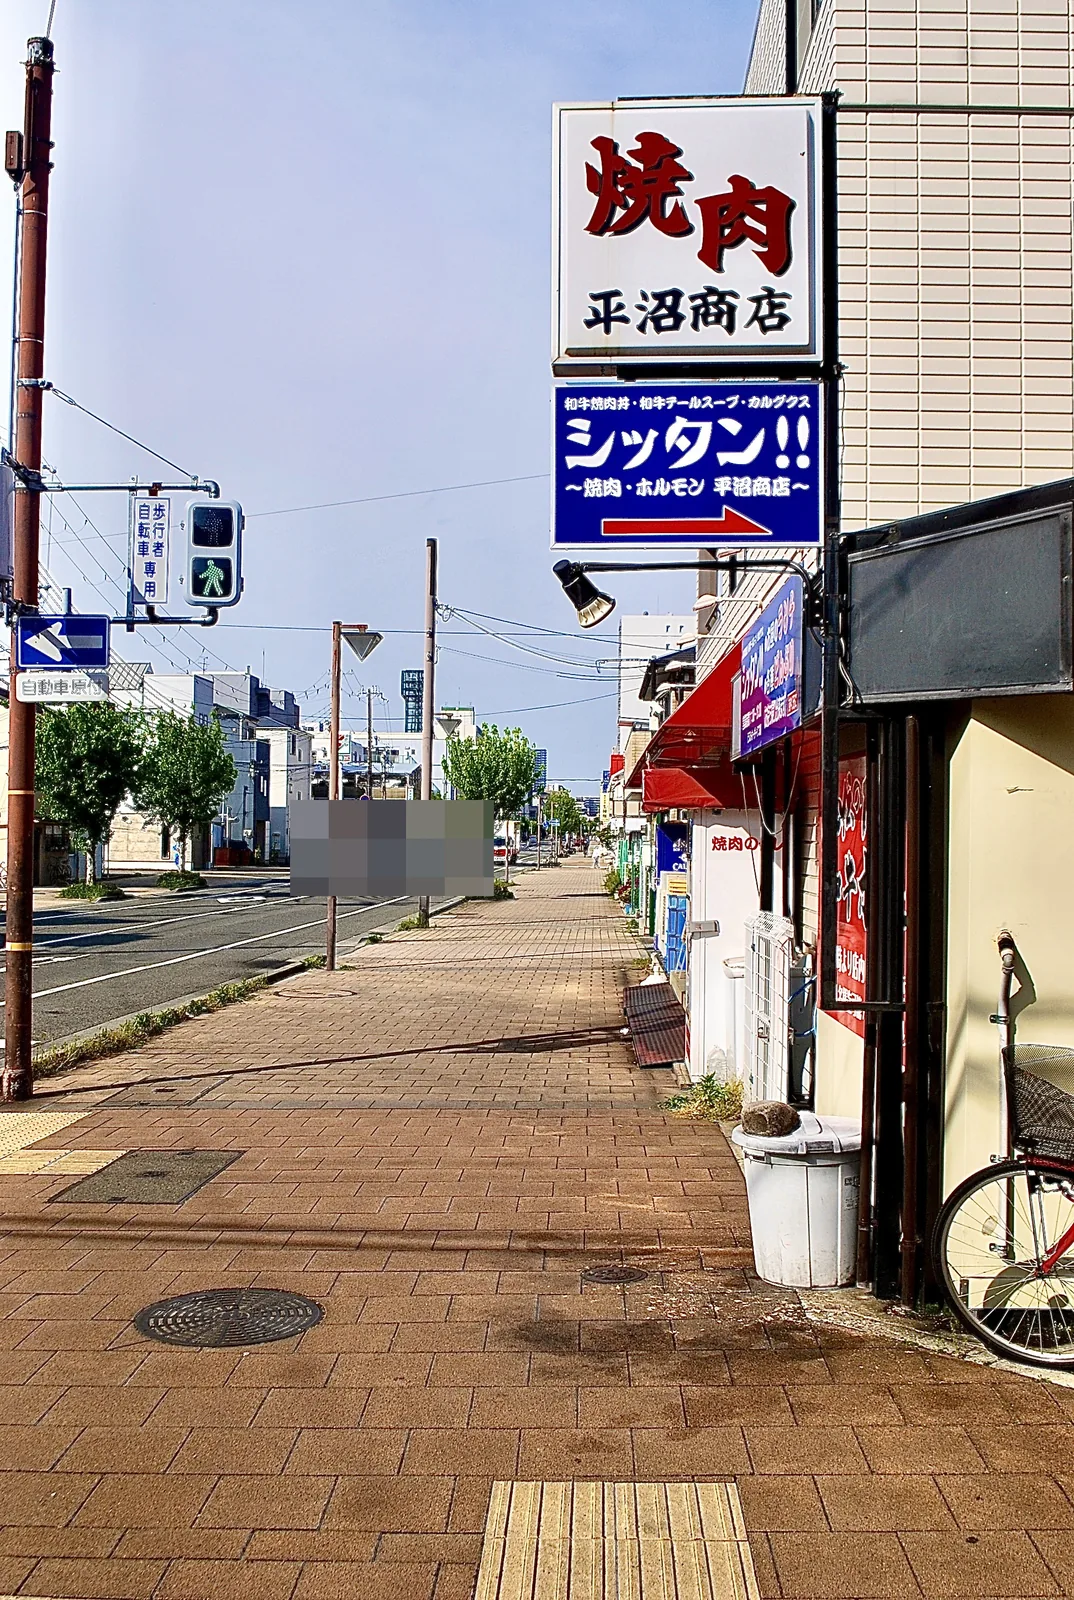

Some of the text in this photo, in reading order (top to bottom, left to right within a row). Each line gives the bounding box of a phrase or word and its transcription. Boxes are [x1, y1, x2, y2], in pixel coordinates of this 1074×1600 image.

[584, 131, 796, 277] 焼肉
[583, 285, 792, 335] 平沼商店
[565, 415, 811, 470] シッタン!!
[137, 503, 151, 558] 自転車
[152, 503, 166, 558] 歩行者
[143, 561, 157, 598] 専用
